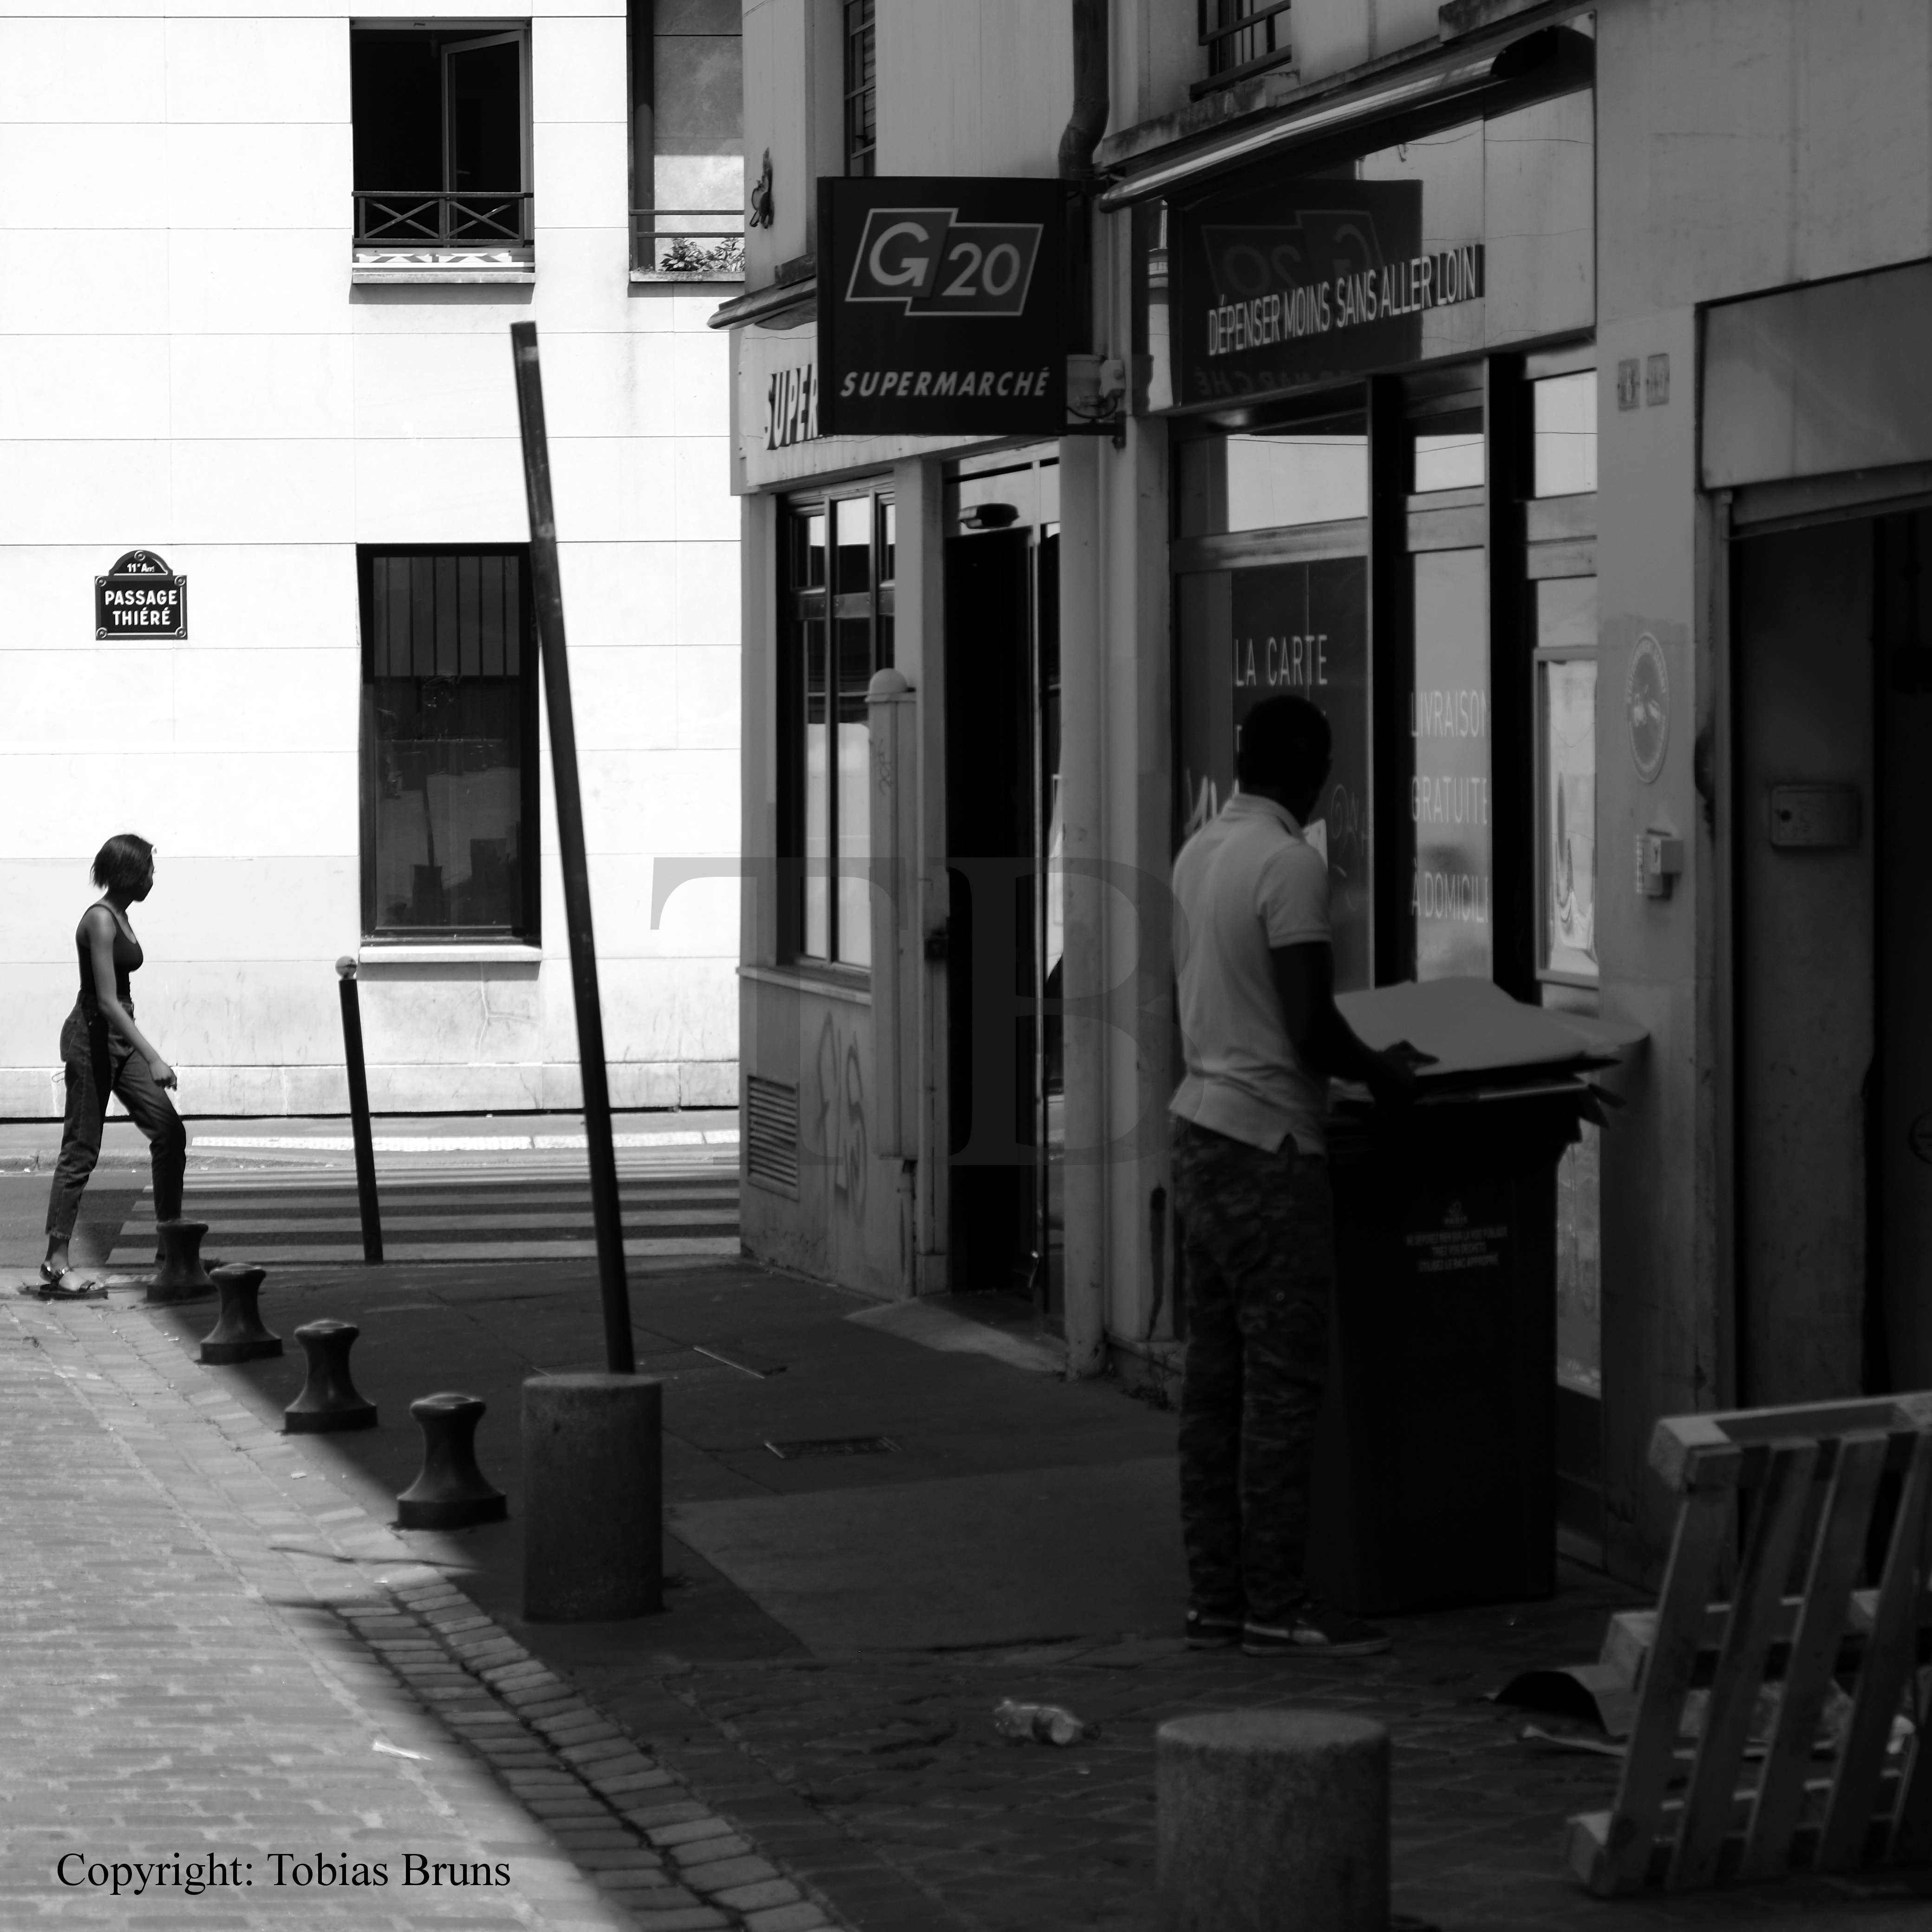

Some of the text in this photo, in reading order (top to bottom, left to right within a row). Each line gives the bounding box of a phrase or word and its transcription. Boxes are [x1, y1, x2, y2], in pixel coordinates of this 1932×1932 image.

[1208, 245, 1476, 356] DÉPENSER MOINS SANS ALLER LOIN
[840, 366, 1051, 397] SUPERMARCHÉ
[105, 590, 177, 605] PASSAGE
[112, 607, 171, 626] THIÉRÉ
[1235, 635, 1328, 686] LA CARTE
[1411, 857, 1421, 917] À
